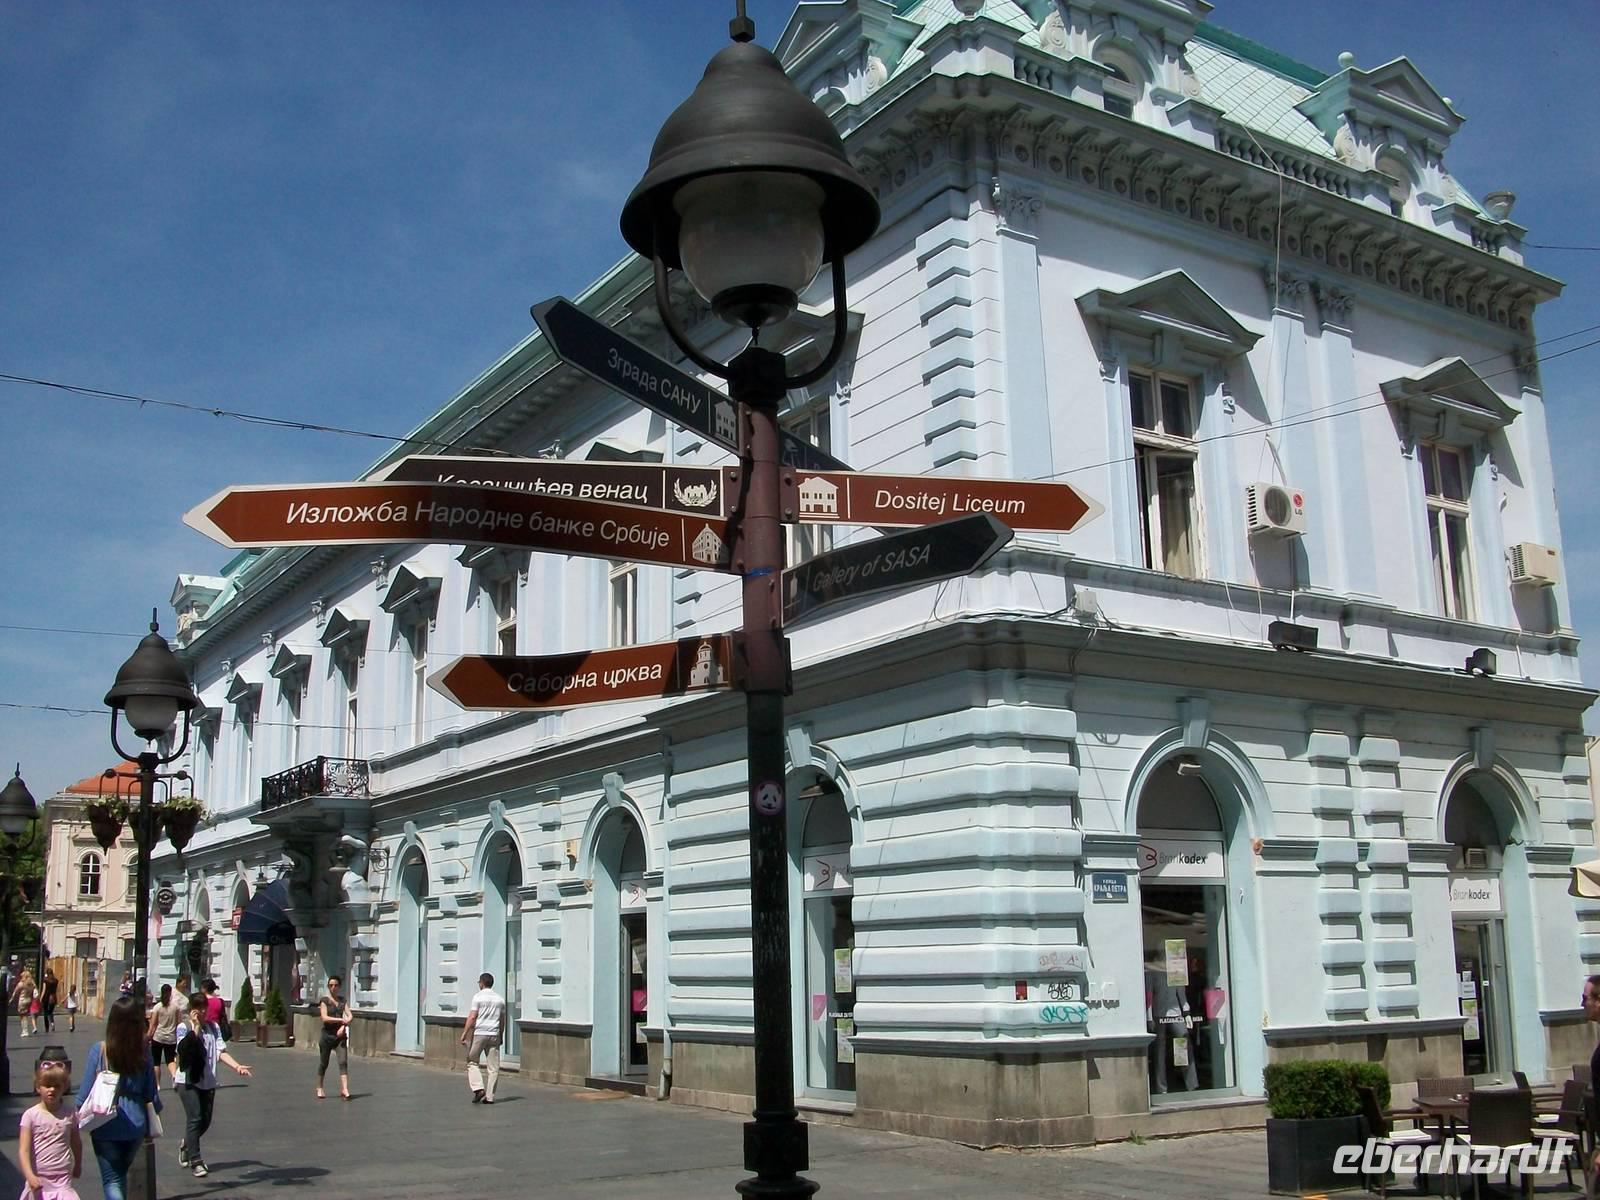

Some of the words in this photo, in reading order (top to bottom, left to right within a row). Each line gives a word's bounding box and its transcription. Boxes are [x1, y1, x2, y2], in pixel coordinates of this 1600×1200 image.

[607, 347, 657, 392] Зграда
[660, 378, 702, 415] САНУ
[578, 481, 649, 504] венац
[874, 489, 947, 516] Dositej
[952, 493, 1026, 515] Liceum
[286, 500, 408, 525] Изложба
[413, 501, 525, 532] Народне
[528, 510, 596, 538] банке
[599, 518, 671, 551] Србије
[813, 563, 859, 590] Gallery
[860, 553, 882, 577] of
[882, 544, 930, 571] SASA
[506, 671, 598, 695] Саборна
[602, 661, 663, 689] црква
